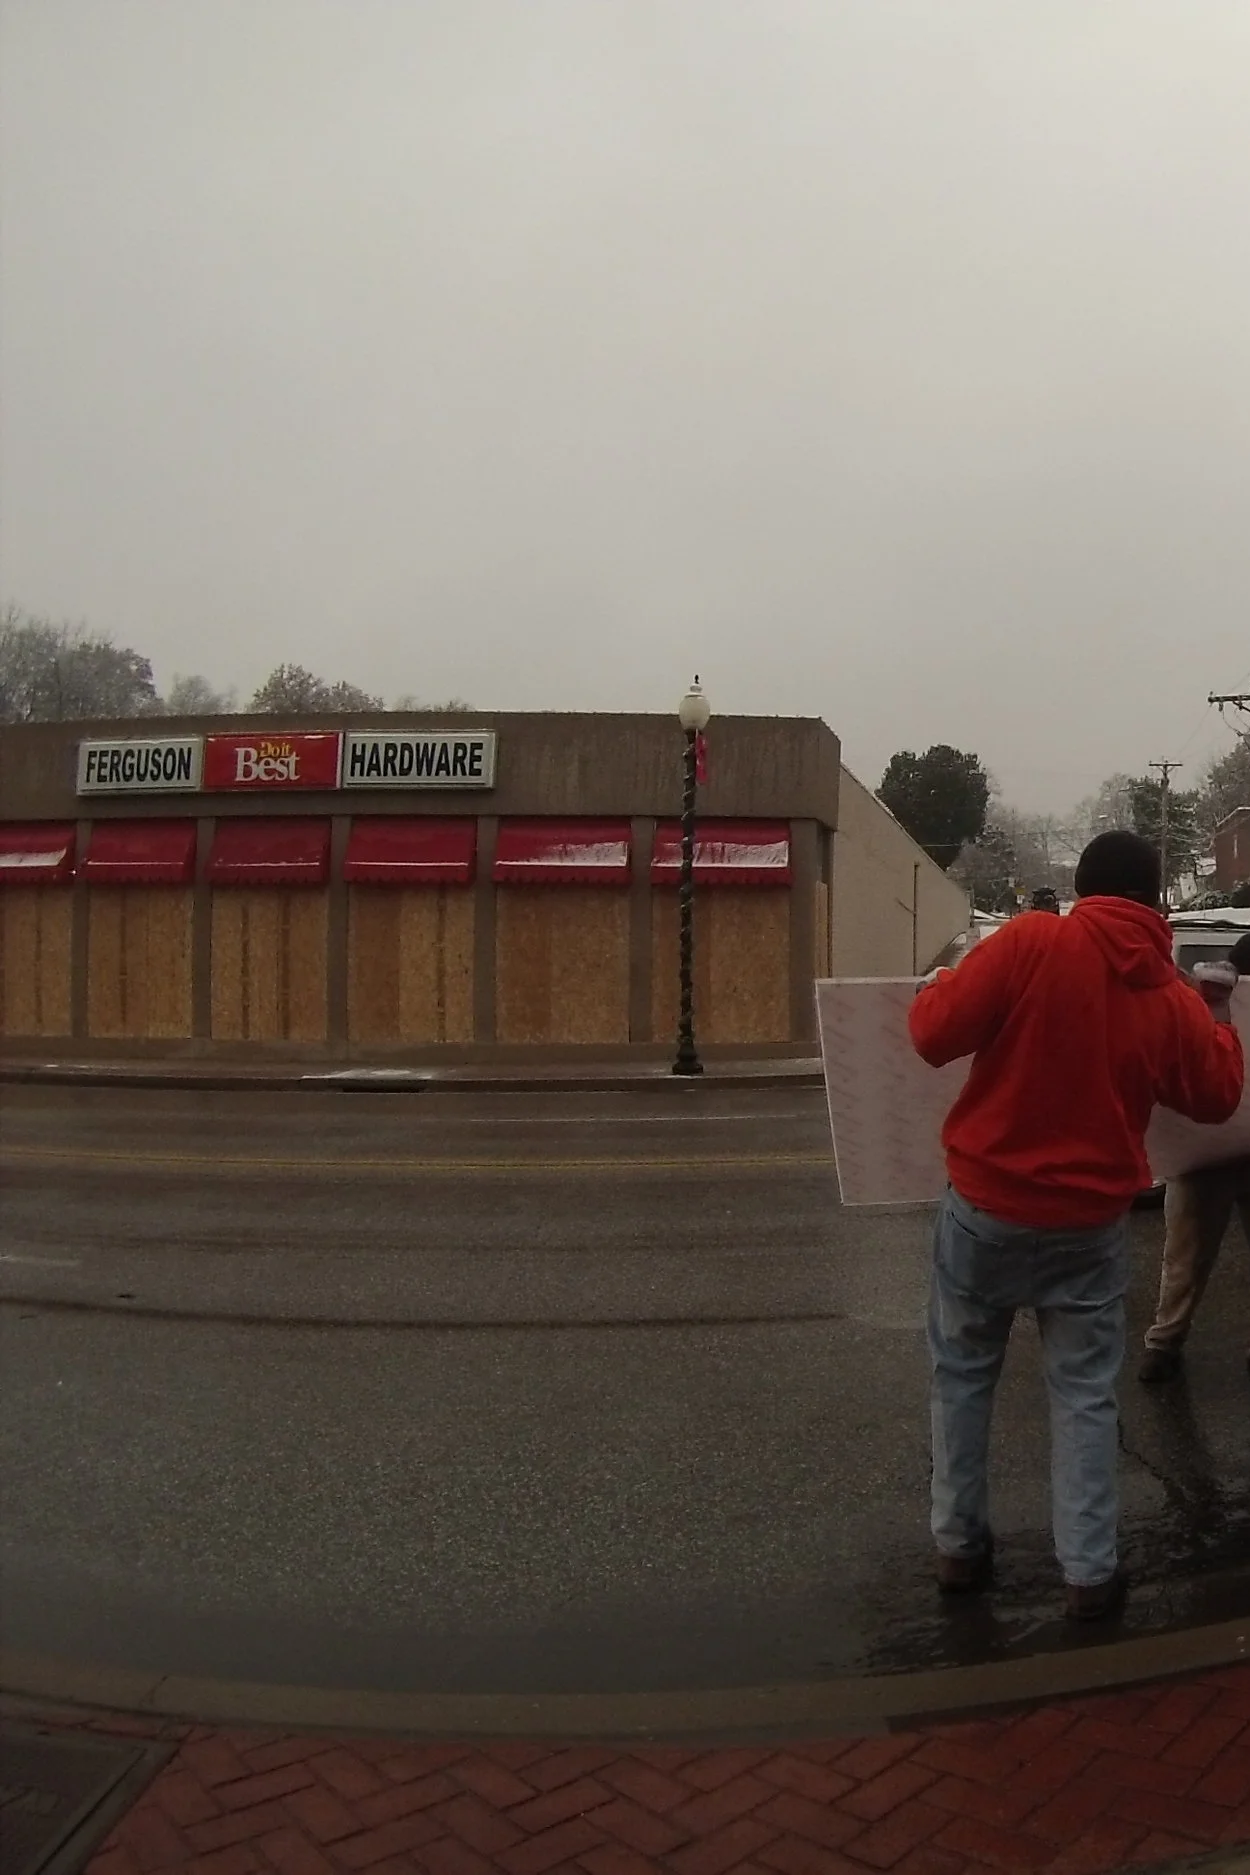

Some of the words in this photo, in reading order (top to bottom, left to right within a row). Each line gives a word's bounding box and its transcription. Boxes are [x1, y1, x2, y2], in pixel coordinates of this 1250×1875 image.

[86, 747, 193, 783] FERGUSON
[235, 747, 300, 781] Best
[260, 741, 280, 757] Do
[281, 742, 291, 757] it
[350, 742, 484, 777] HARDWARE
